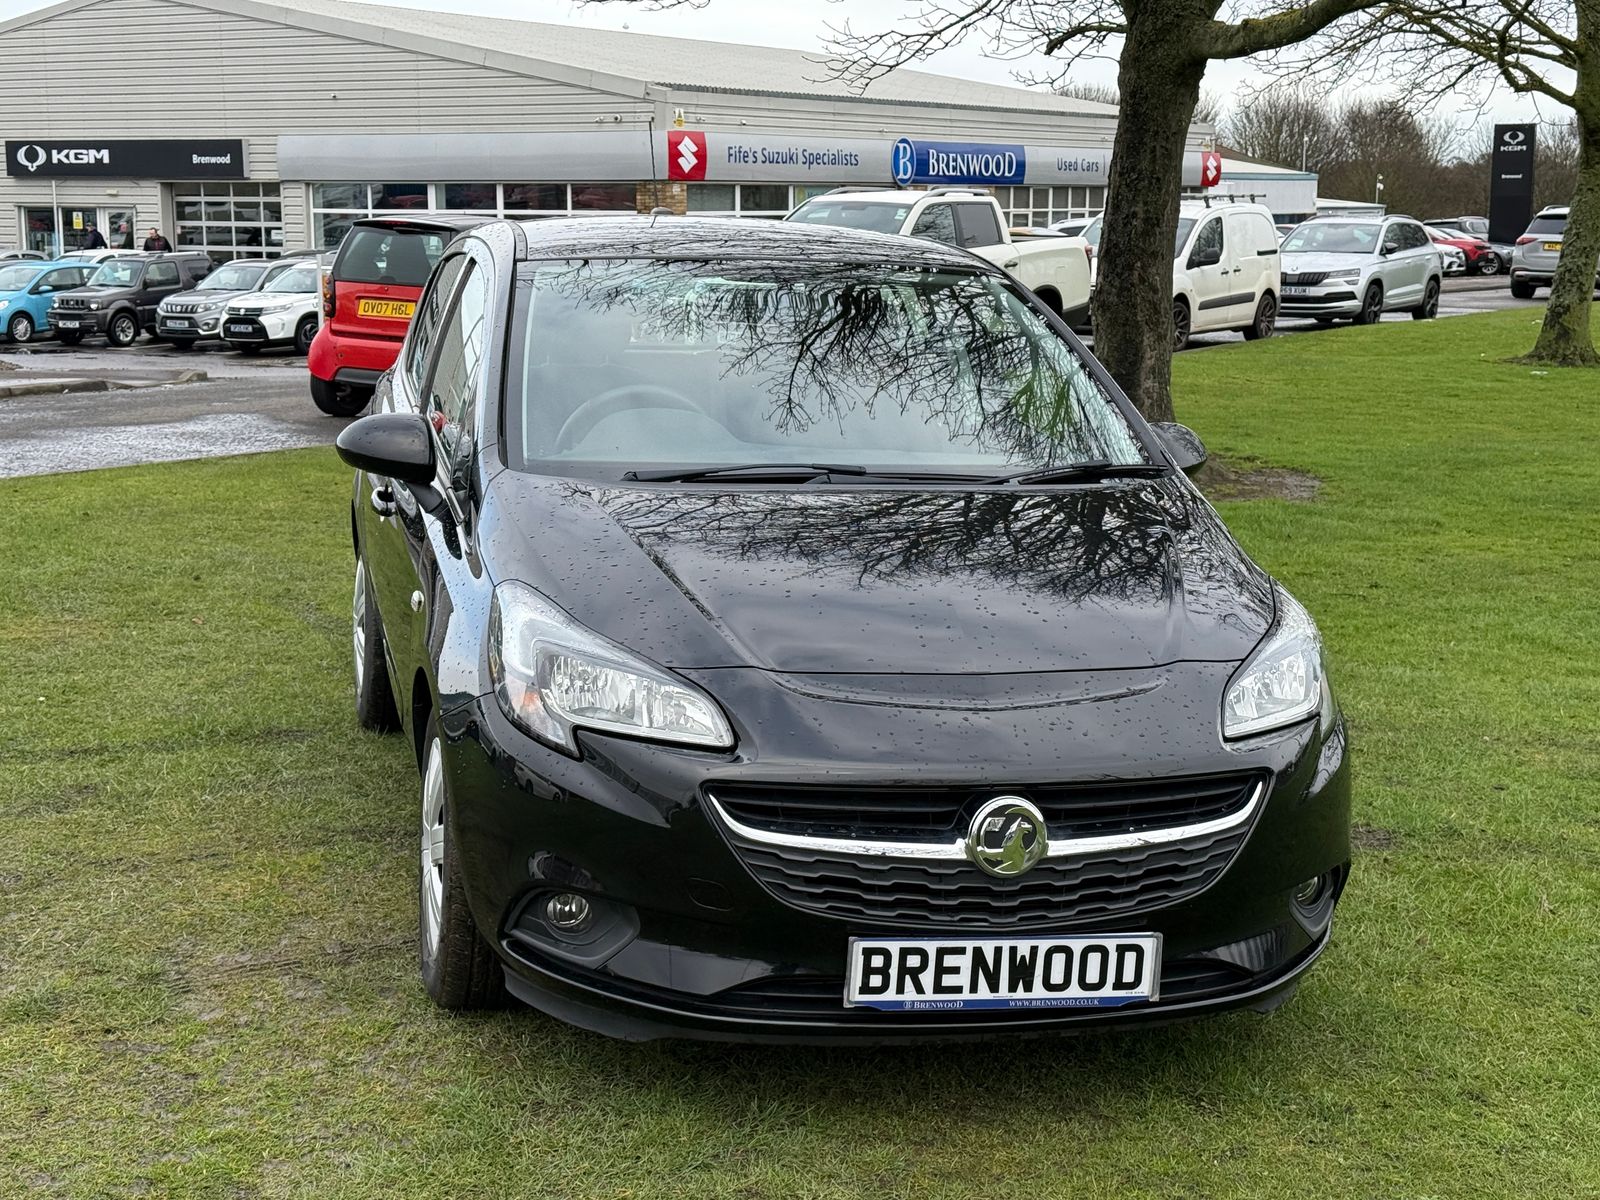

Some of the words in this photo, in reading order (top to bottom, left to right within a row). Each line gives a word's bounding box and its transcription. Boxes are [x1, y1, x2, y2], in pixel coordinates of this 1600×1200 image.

[52, 149, 109, 164] KGM
[192, 153, 231, 164] Brenwood
[727, 146, 758, 164] Fife's
[761, 147, 799, 165] Suzuki
[801, 149, 859, 170] Specialists
[928, 149, 1017, 177] BRENWOOD
[1056, 157, 1078, 172] Used
[1080, 158, 1099, 173] Cars
[363, 301, 390, 314] OV07
[391, 303, 410, 315] HGL
[858, 943, 1145, 996] BRENWOOD
[914, 1001, 963, 1009] BRENWOOD
[1009, 998, 1100, 1007] WWW.BRENWOOD.CO.UK
